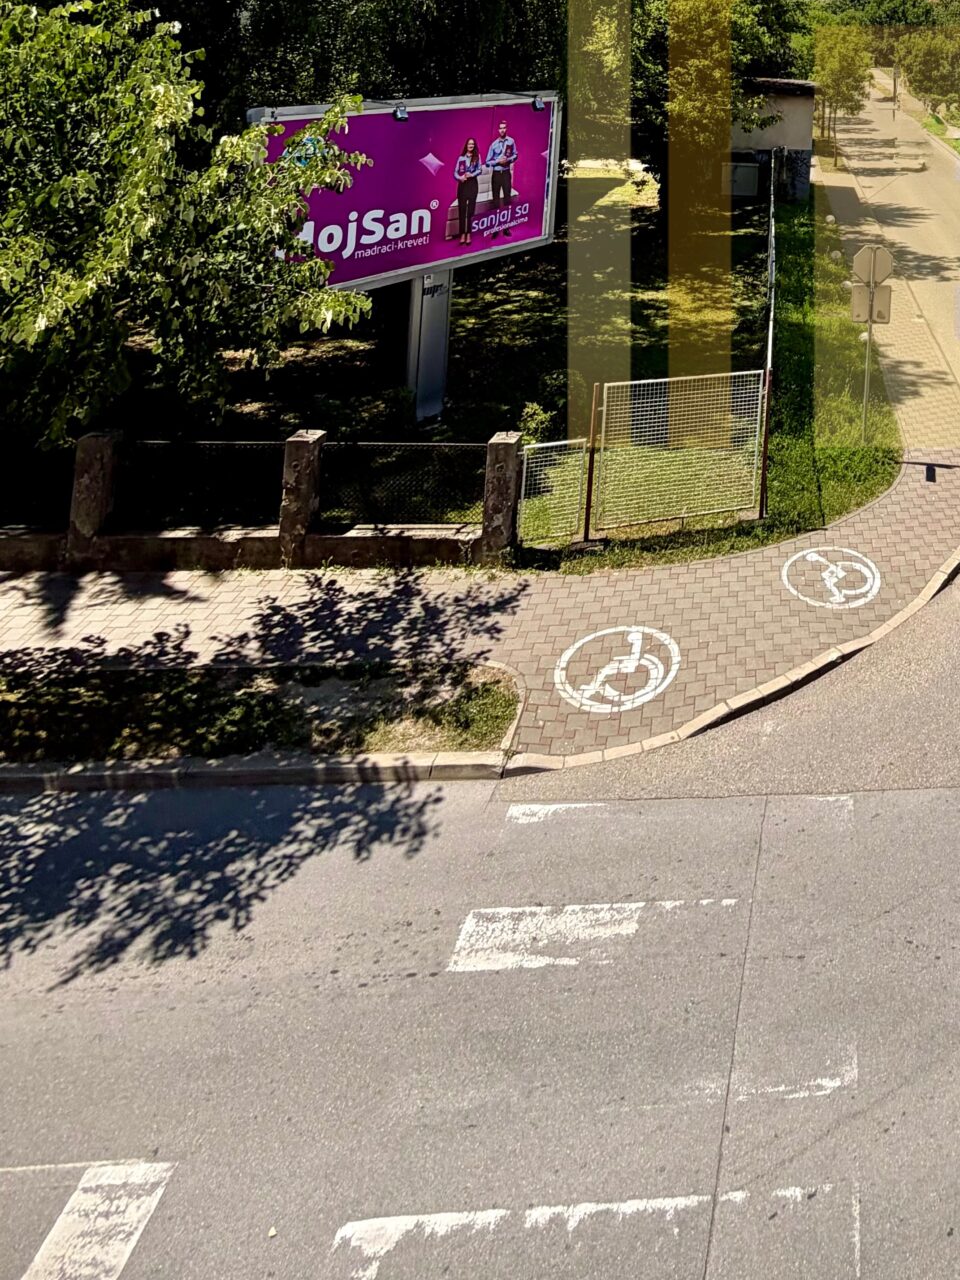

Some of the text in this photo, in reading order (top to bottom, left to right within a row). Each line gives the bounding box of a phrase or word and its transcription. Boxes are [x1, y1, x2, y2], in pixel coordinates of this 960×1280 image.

[471, 203, 529, 232] sanjaj sa
[354, 234, 430, 259] madraci-kreveti
